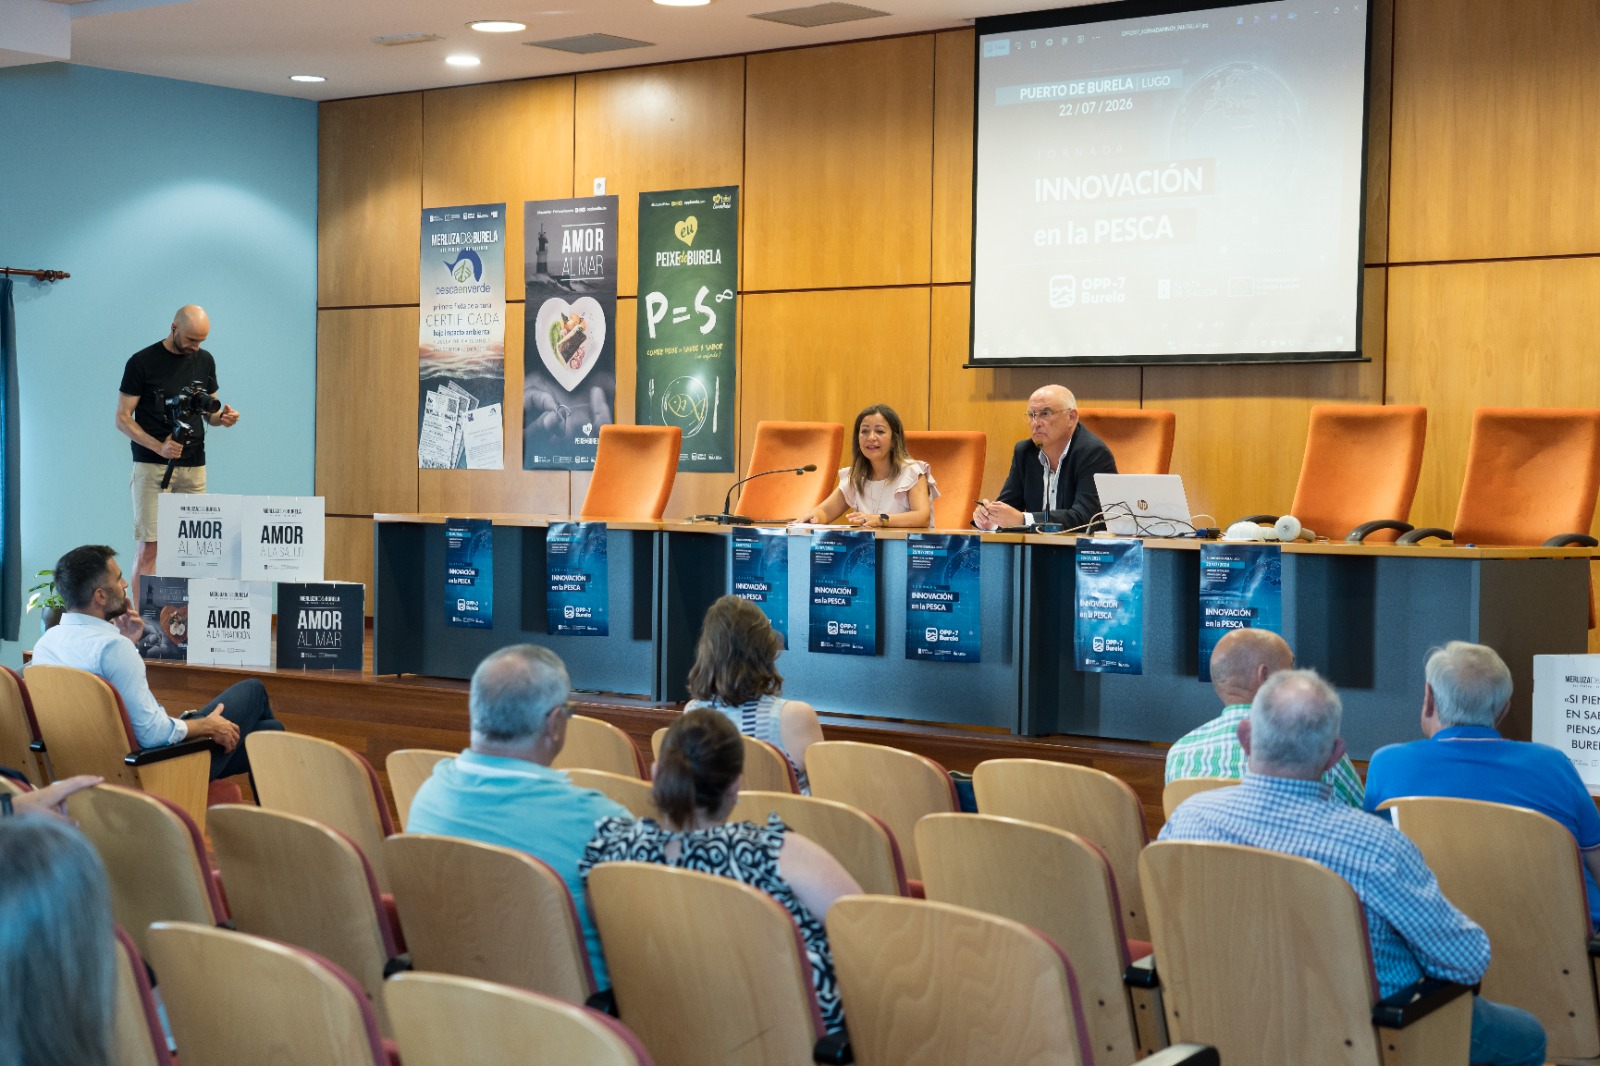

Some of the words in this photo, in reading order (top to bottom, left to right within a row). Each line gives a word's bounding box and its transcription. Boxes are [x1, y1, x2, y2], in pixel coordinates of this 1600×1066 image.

[1020, 84, 1067, 100] PUERTO
[1069, 82, 1087, 96] DE
[1087, 77, 1134, 94] BURELA
[1142, 75, 1171, 88] LUGO
[1059, 104, 1073, 117] 22
[1081, 102, 1096, 115] 07
[1105, 98, 1134, 114] 2026
[1035, 163, 1204, 202] INNOVACIÓN
[680, 223, 695, 238] eu
[1033, 227, 1061, 247] en
[1067, 220, 1088, 245] la
[1094, 214, 1175, 244] PESCA
[561, 227, 604, 254] AMOR
[561, 256, 576, 277] AL
[578, 254, 604, 276] MAR
[1081, 276, 1126, 290] OPP-7
[1081, 290, 1126, 304] Burela
[178, 519, 223, 540] AMOR
[260, 525, 304, 545] AMOR
[178, 540, 193, 556] AL
[196, 540, 222, 556] MAR
[551, 574, 587, 582] INNOVACIÓN
[746, 593, 763, 601] PESCA
[814, 586, 852, 595] INNOVACIÓN
[911, 592, 953, 601] INNOVACIÓN
[919, 602, 926, 610] la
[926, 603, 947, 611] PESCA
[1205, 607, 1252, 617] INNOVACIÓN
[206, 609, 251, 630] AMOR
[297, 609, 342, 631] AMOR
[1093, 611, 1113, 620] PESCA
[1214, 620, 1221, 628] la
[1221, 620, 1245, 629] PESCA
[297, 631, 313, 647] AL
[315, 631, 342, 647] MAR
[1566, 709, 1581, 719] EN
